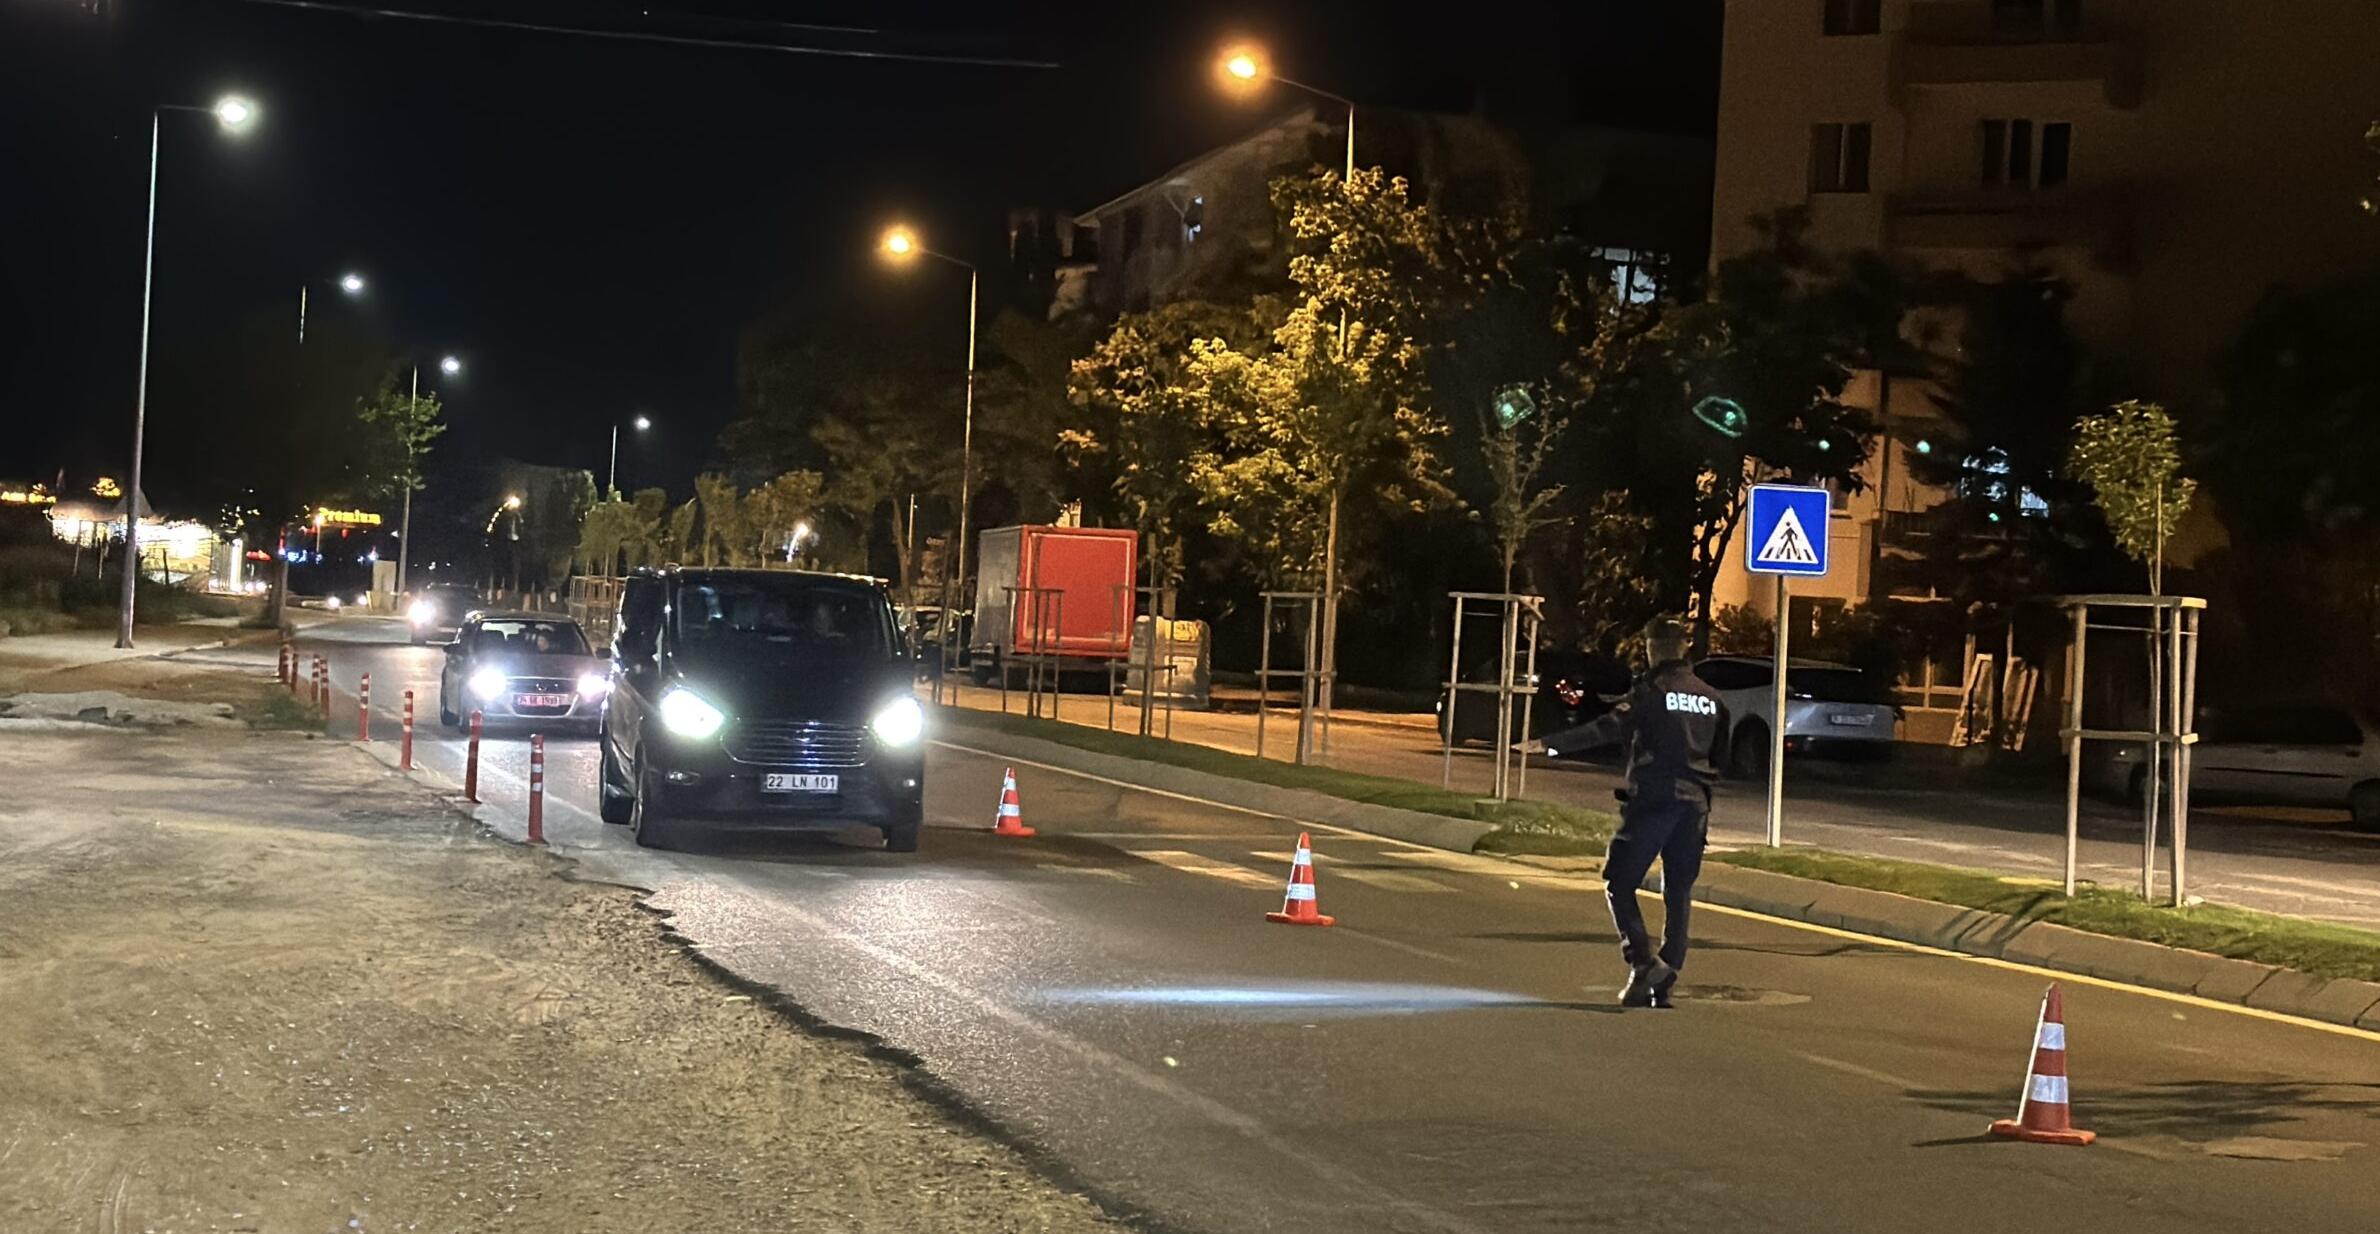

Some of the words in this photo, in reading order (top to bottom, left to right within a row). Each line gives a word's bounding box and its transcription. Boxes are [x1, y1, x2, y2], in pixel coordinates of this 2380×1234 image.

[768, 776, 783, 787] 22
[792, 776, 807, 788] LN
[814, 776, 835, 789] 101
